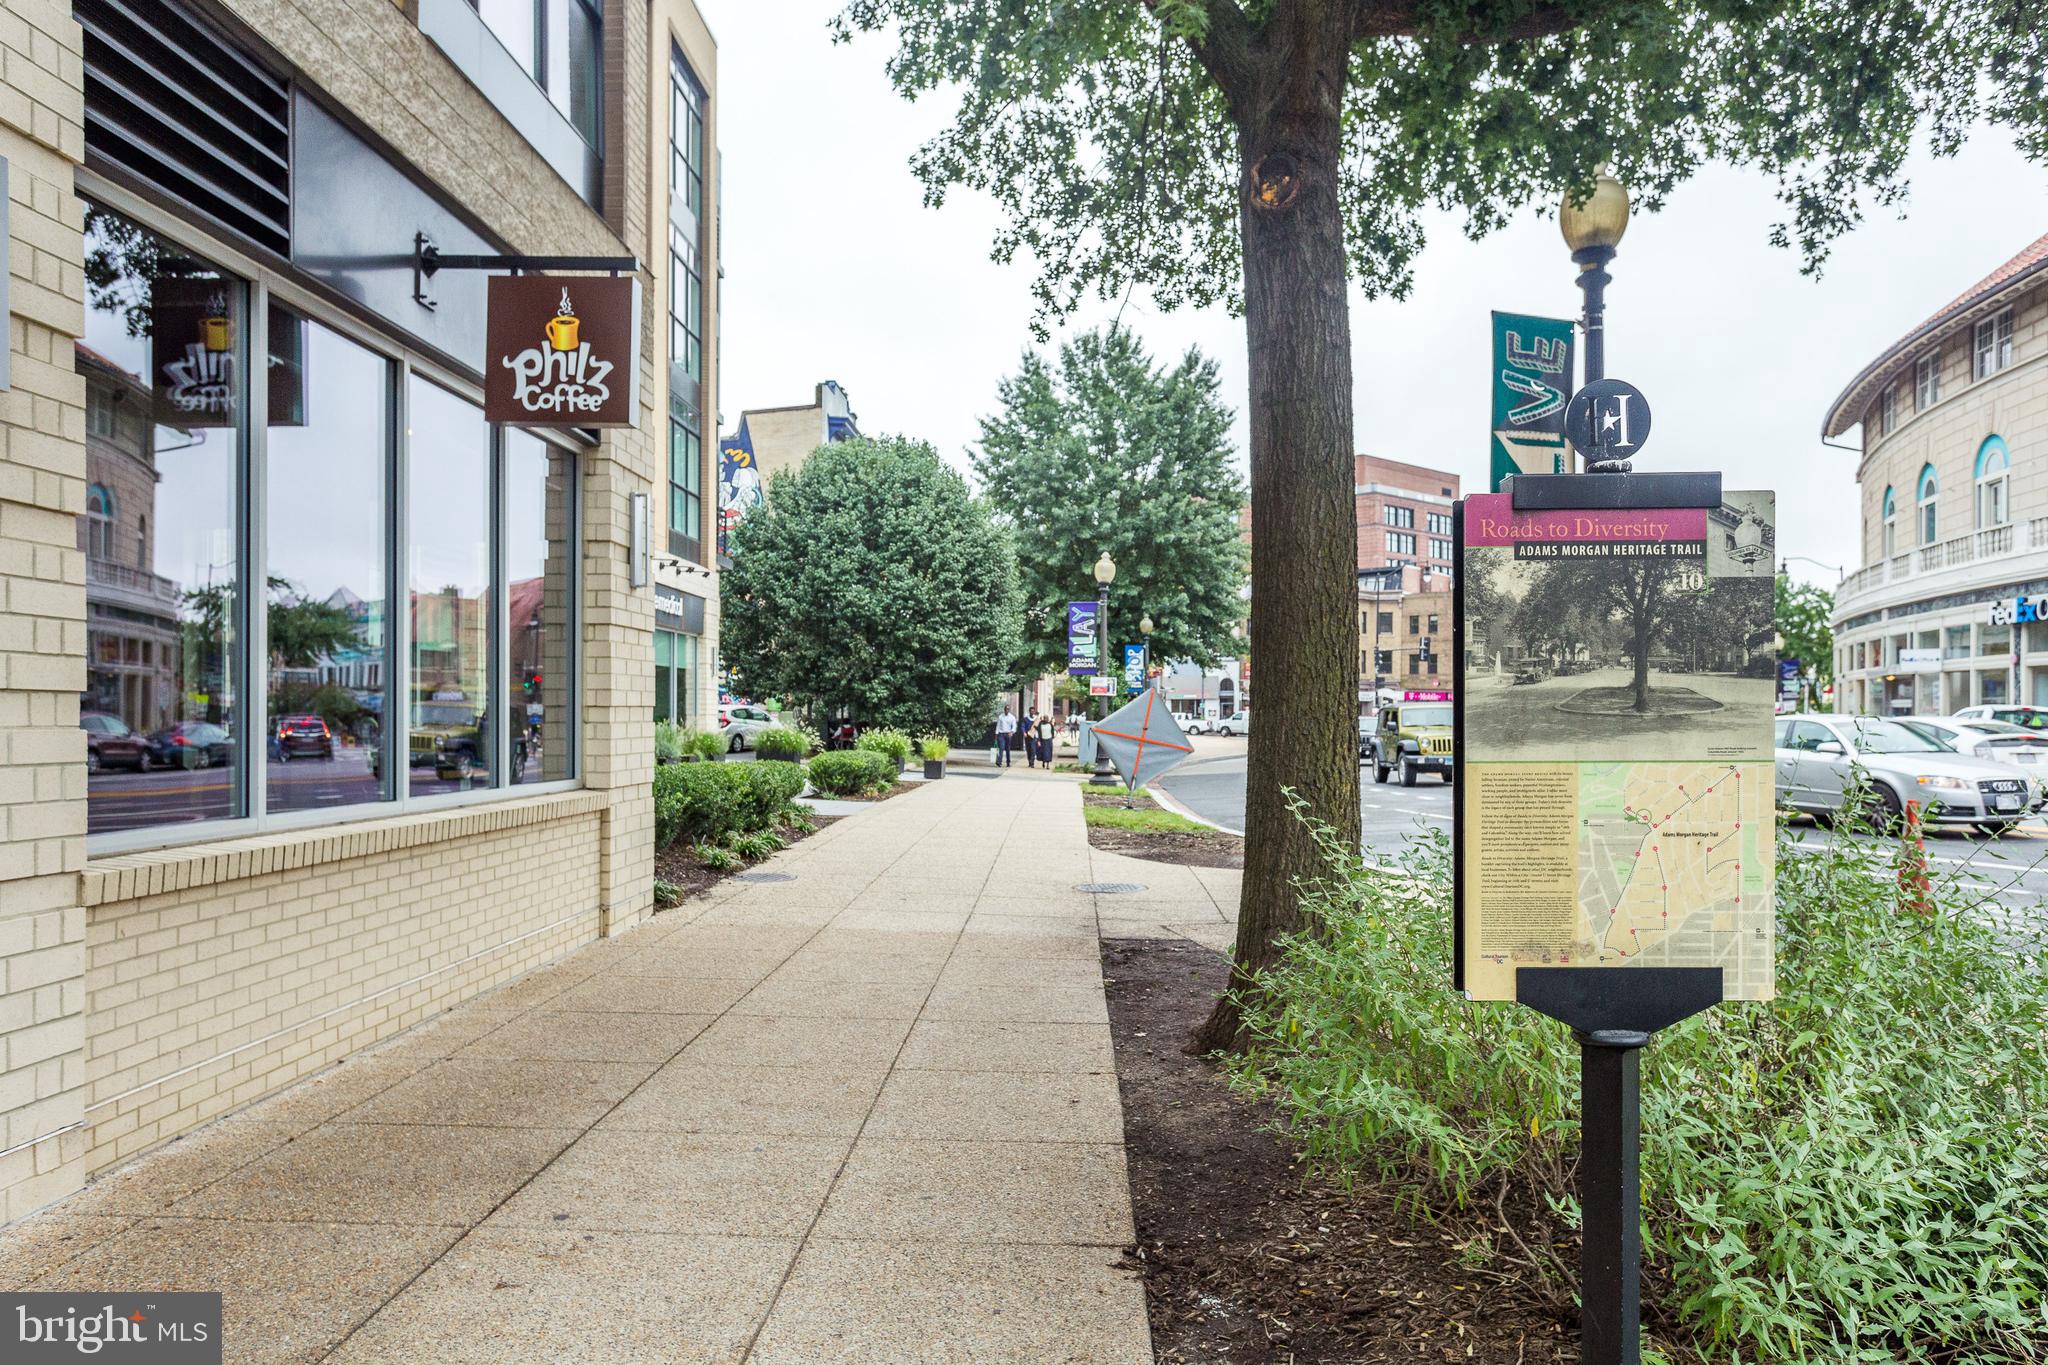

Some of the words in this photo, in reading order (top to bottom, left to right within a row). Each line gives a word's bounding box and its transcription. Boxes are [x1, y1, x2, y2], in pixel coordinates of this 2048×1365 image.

[521, 383, 603, 413] Coffee
[1481, 518, 1543, 538] Roads
[1549, 521, 1568, 537] to
[1574, 517, 1670, 542] Diversity
[1519, 545, 1557, 557] ADAMS
[1561, 544, 1607, 556] MORGAN
[1613, 543, 1667, 556] HERITAGE
[1671, 543, 1703, 556] TRAIL
[1679, 572, 1703, 591] 10
[1987, 597, 2037, 626] FedEx
[1069, 606, 1097, 658] PLAY
